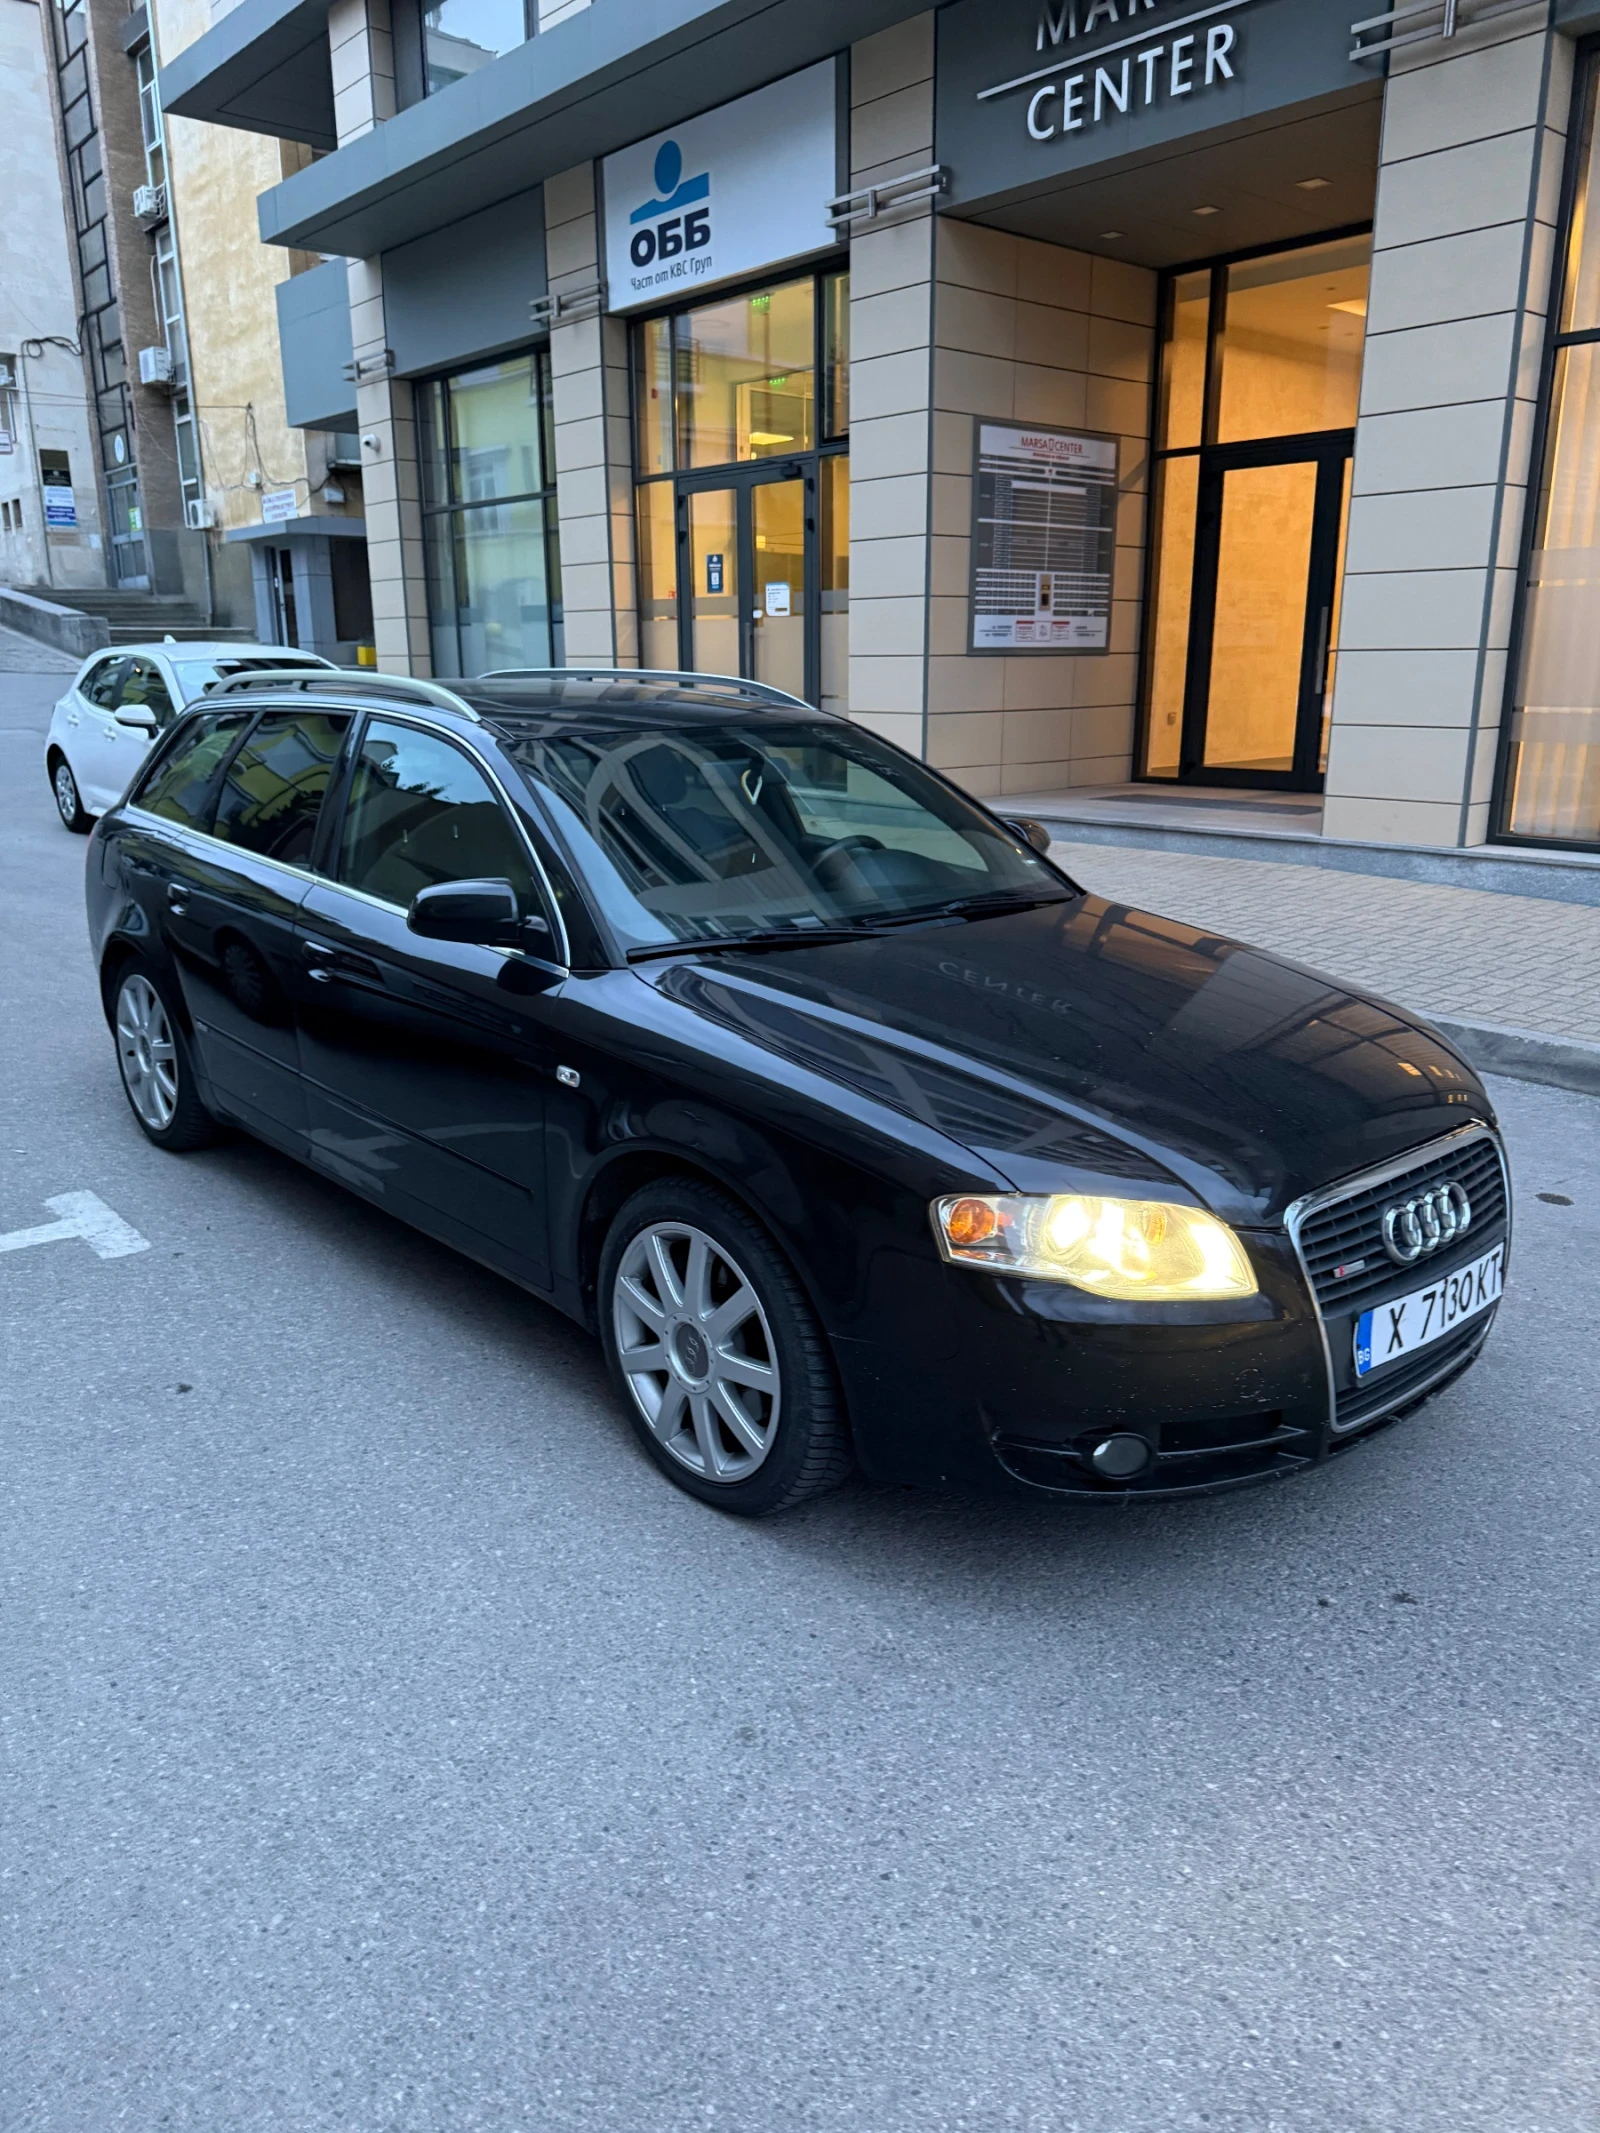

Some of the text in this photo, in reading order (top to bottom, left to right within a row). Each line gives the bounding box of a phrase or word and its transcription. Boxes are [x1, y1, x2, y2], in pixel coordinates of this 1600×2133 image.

[1036, 0, 1155, 51] MA
[1027, 23, 1235, 140] CENTER
[630, 207, 711, 267] ОББ
[630, 256, 712, 291] Част от КВС Груп
[1021, 436, 1084, 454] MARSA CENTER
[1387, 1303, 1407, 1354] X
[1357, 1347, 1371, 1365] BG
